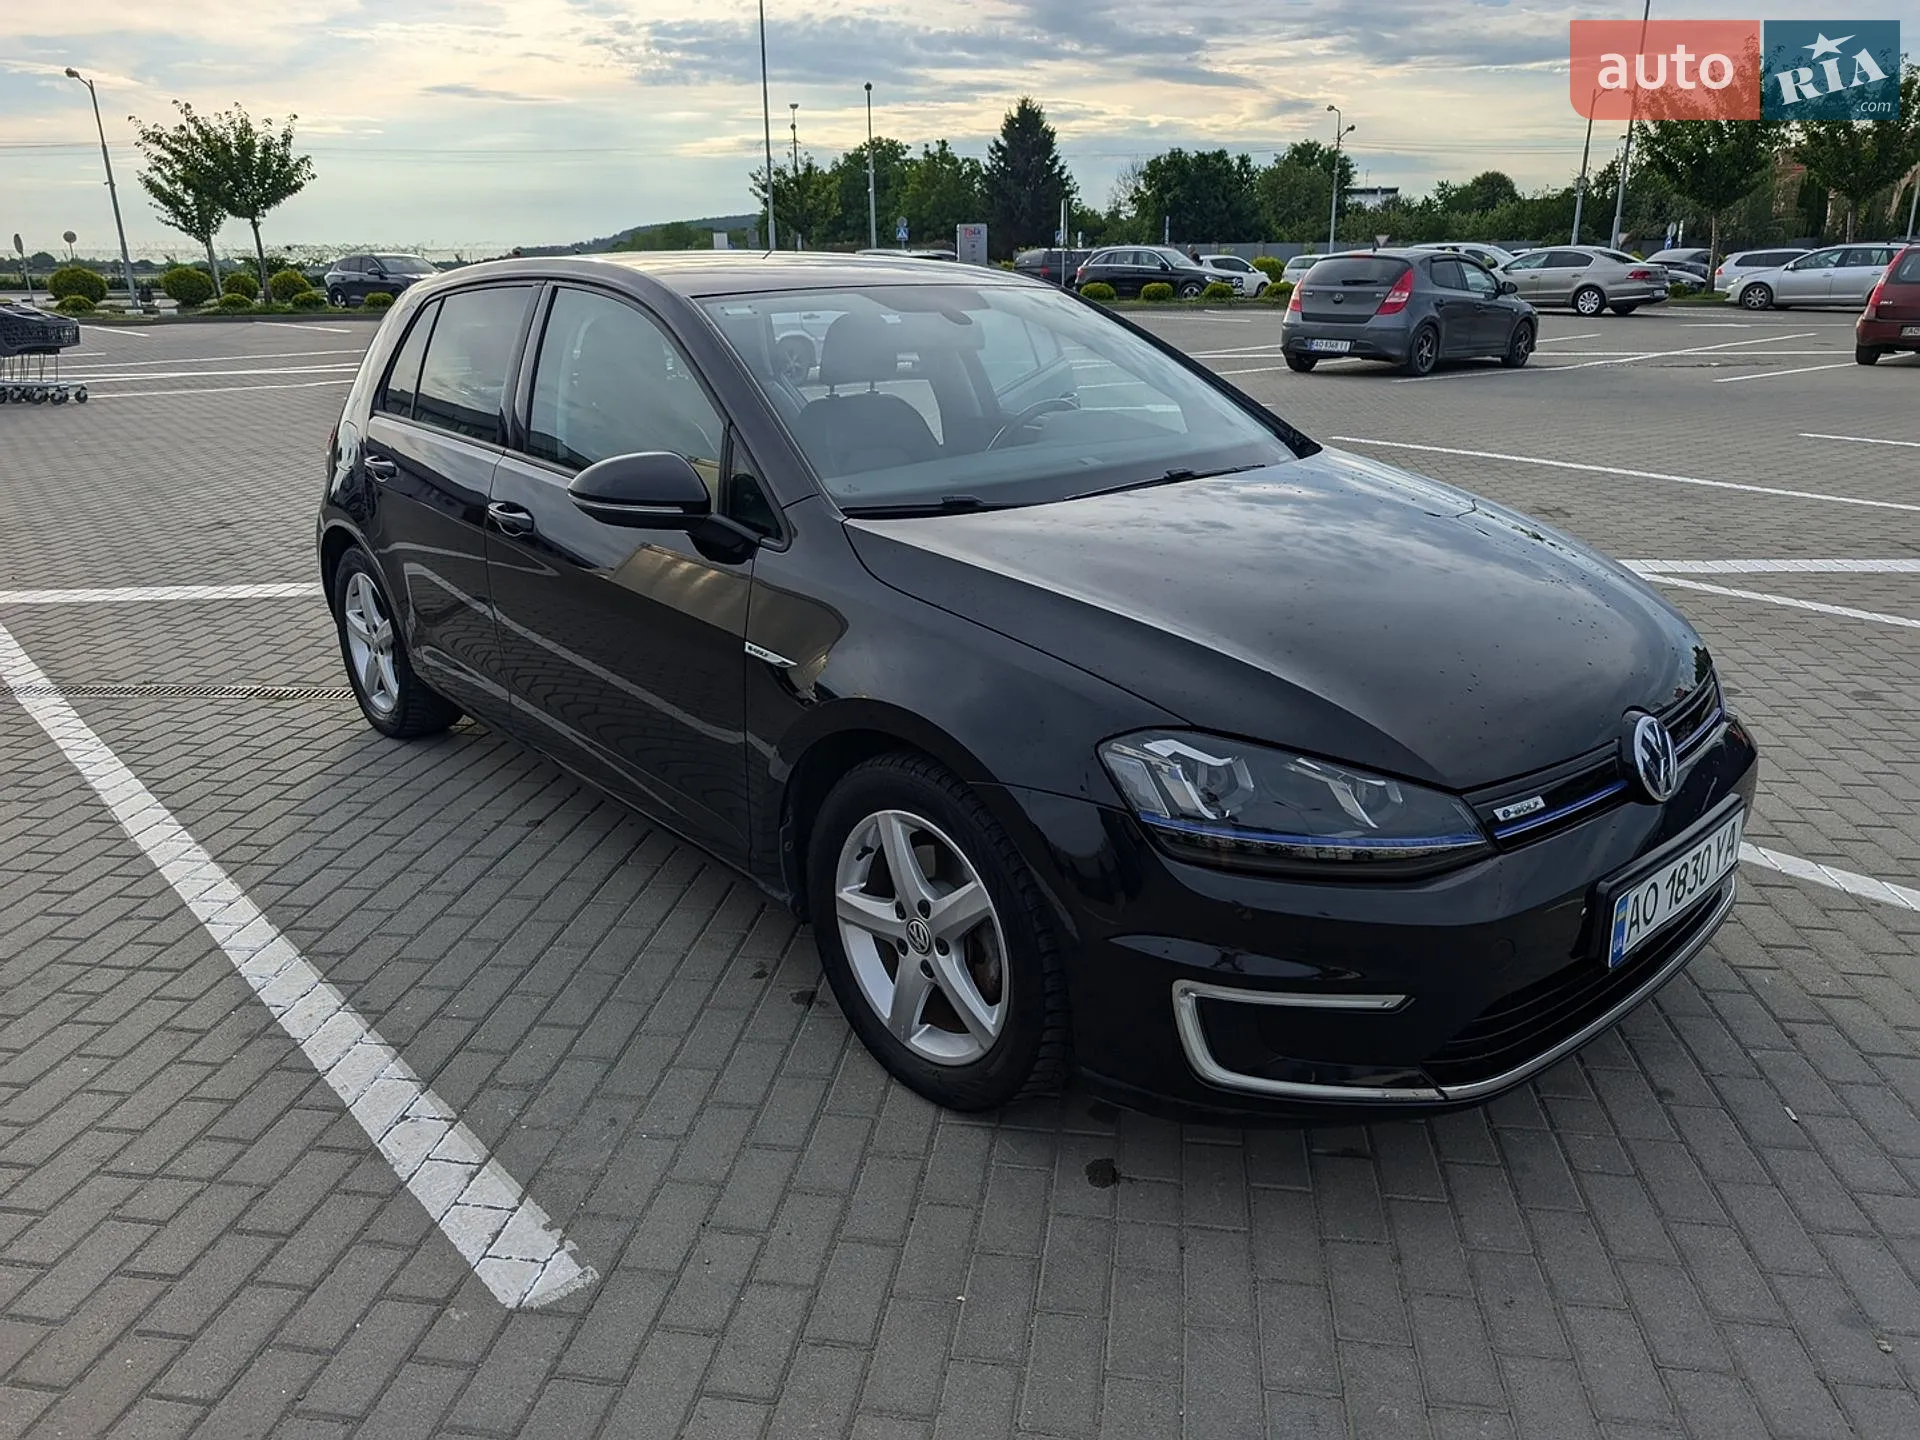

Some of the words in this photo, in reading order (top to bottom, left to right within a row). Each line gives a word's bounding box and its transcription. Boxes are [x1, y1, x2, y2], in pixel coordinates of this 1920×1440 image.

[1626, 881, 1659, 943] AO
[1665, 843, 1712, 911] 1830
[1716, 820, 1737, 874] YA
